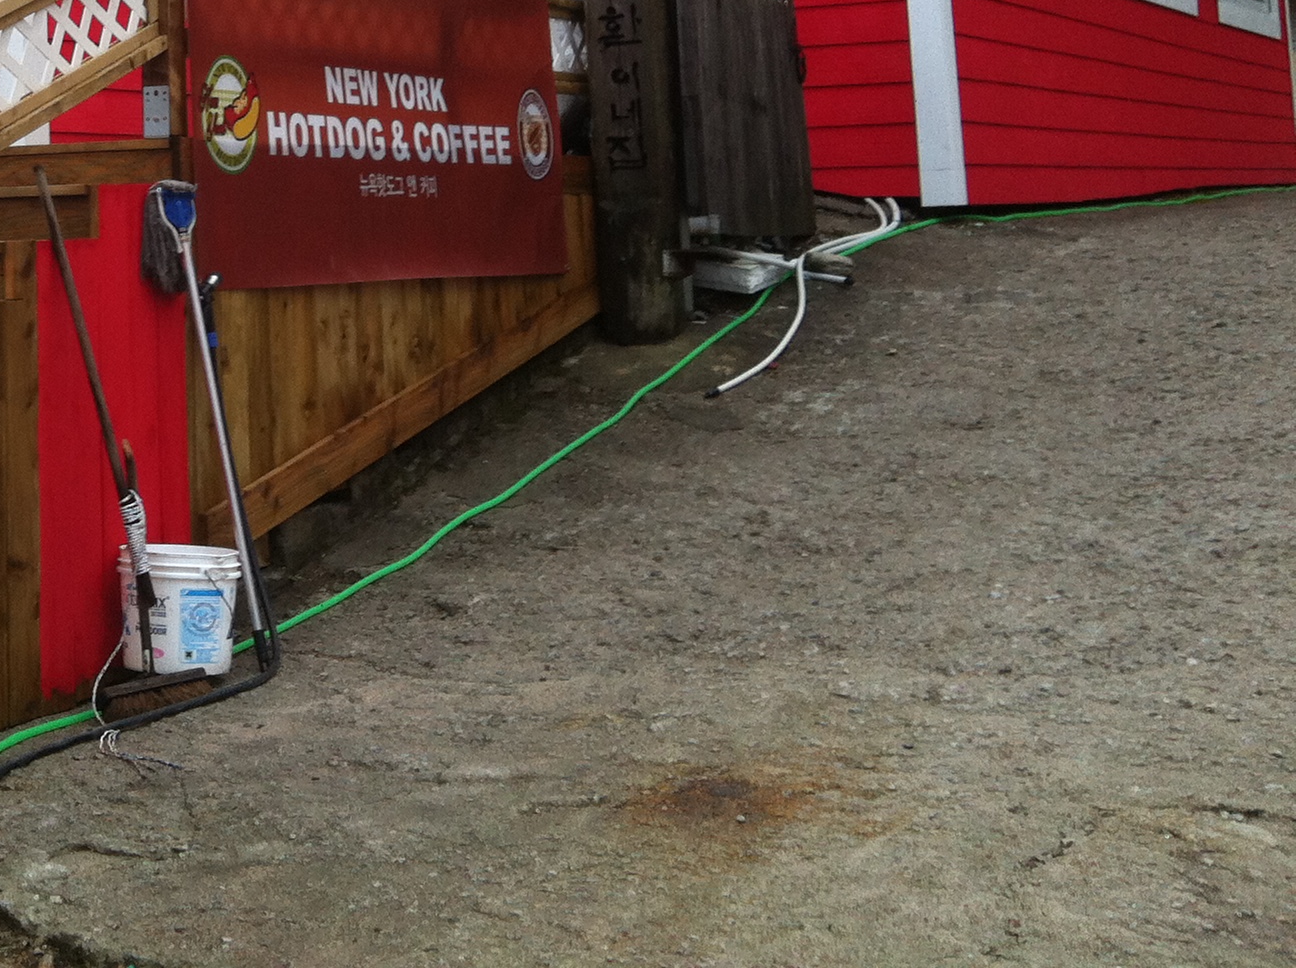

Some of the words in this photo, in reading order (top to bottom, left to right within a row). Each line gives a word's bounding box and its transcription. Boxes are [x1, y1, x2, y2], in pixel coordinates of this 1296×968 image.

[324, 66, 378, 107] NEW
[384, 72, 448, 112] YORK
[266, 110, 385, 161] HOTDOG
[391, 121, 410, 161] &
[414, 121, 512, 165] COFFEE
